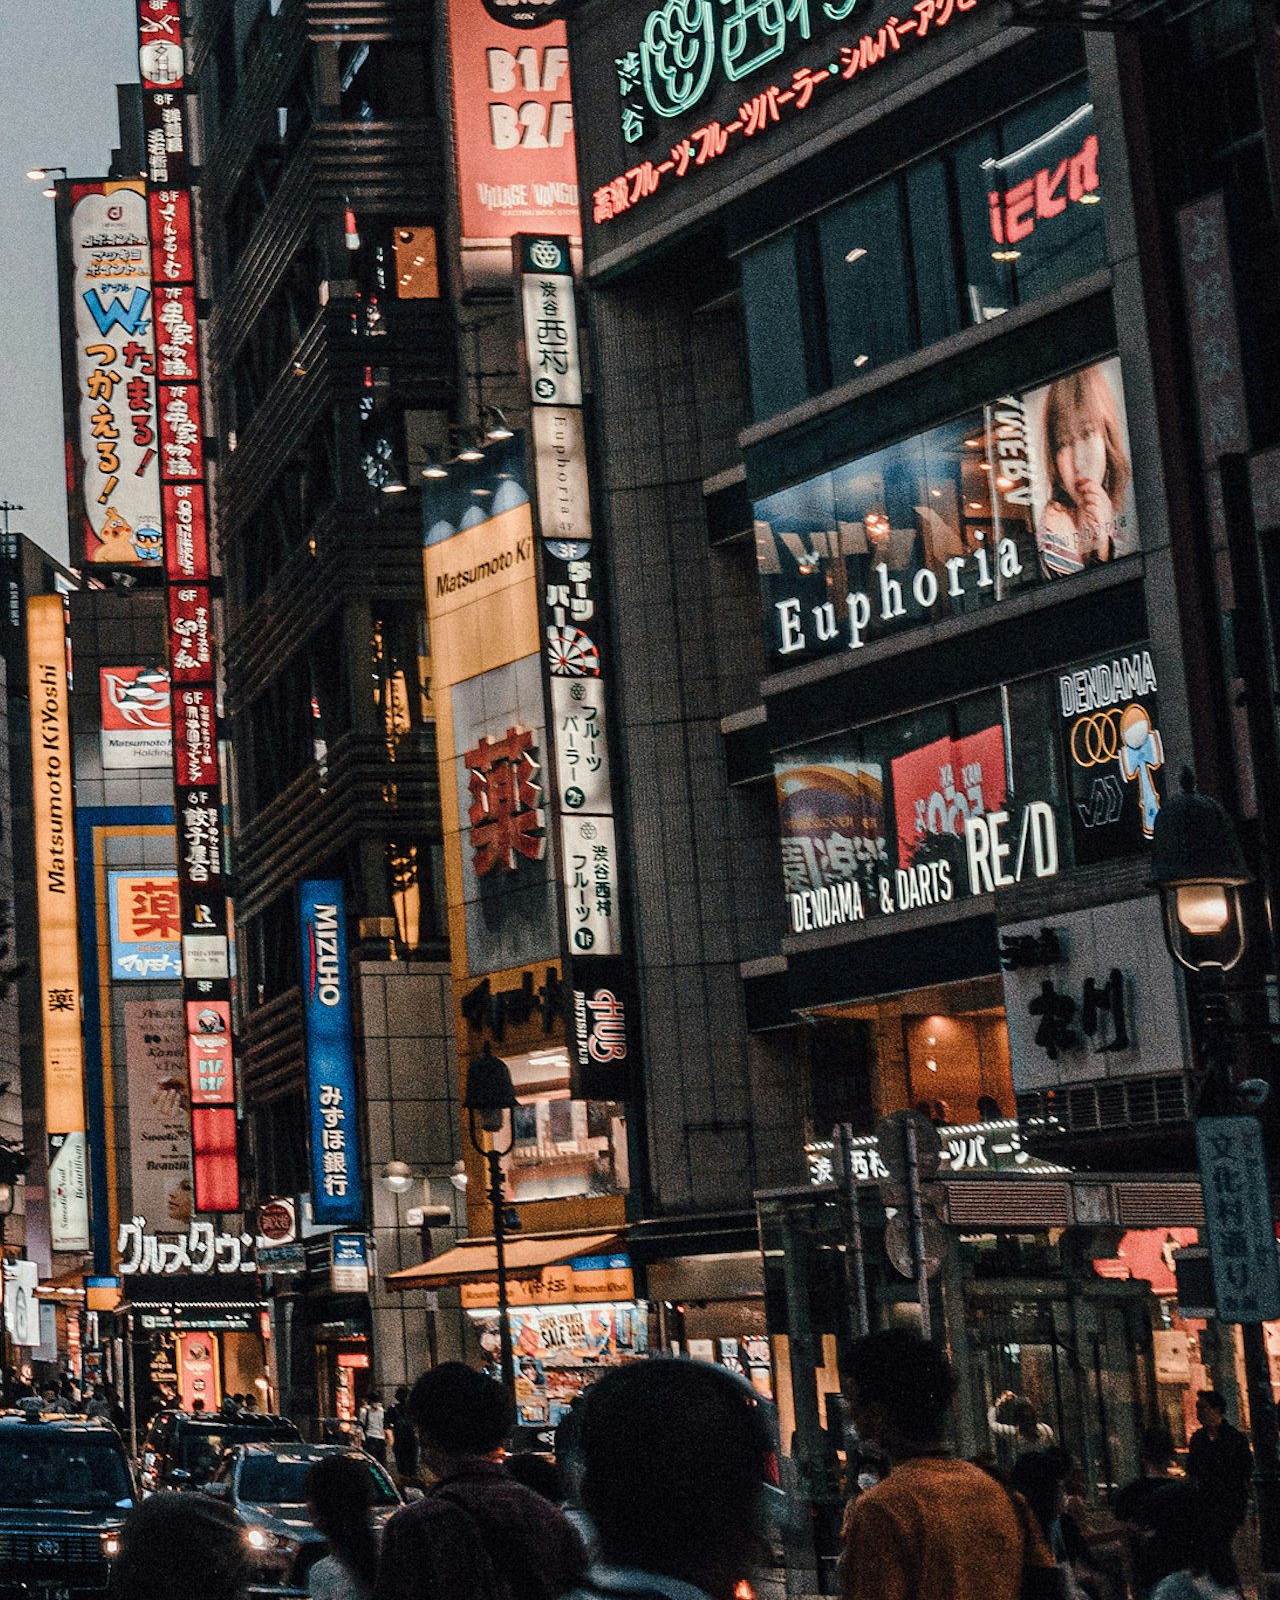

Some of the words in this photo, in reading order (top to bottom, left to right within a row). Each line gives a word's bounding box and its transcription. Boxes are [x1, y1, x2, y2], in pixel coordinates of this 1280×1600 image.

[487, 46, 569, 93] B1F
[614, 49, 641, 144] 渋谷
[490, 100, 574, 150] B2F
[475, 182, 529, 211] VILLAGE
[84, 342, 126, 506] つかえる!
[553, 415, 572, 516] Euphoria
[435, 551, 514, 598] Matsumoto
[557, 542, 578, 559] 3F
[177, 589, 198, 602] 6F
[774, 530, 1023, 656] Euphoria
[40, 663, 61, 752] KiYoshi
[182, 691, 204, 705] 6F
[1059, 652, 1158, 718] DENDAMA
[562, 714, 583, 783] パーラー
[581, 705, 602, 772] フルーツ
[48, 755, 67, 895] Matsumoto
[187, 791, 209, 805] 6F
[571, 854, 592, 923] フルーツ
[591, 843, 612, 917] 渋谷西村
[791, 880, 865, 932] DENDAMA
[878, 877, 895, 915] &
[896, 860, 953, 912] DARTS
[965, 802, 1058, 896] RE/D
[312, 903, 340, 1008] MIZUHO
[48, 988, 75, 1012] 薬
[586, 985, 628, 1063] HUB
[319, 1085, 348, 1198] みずほ銀行
